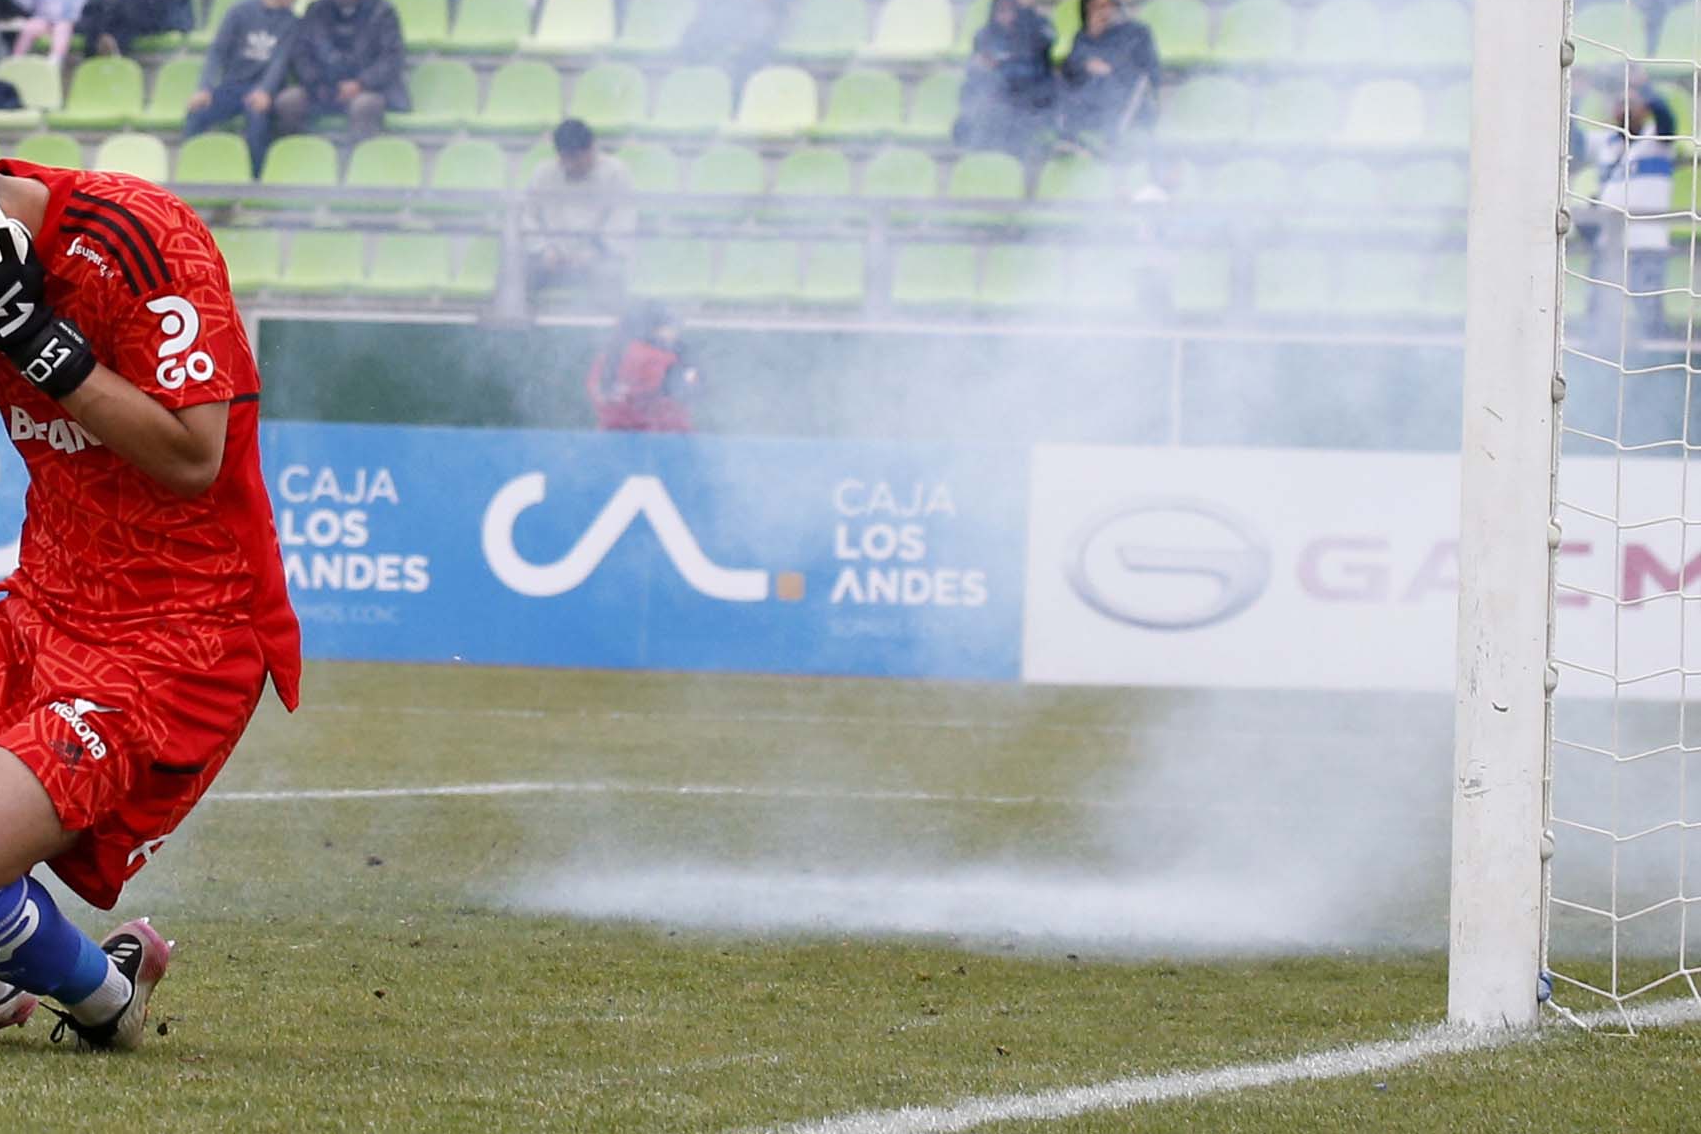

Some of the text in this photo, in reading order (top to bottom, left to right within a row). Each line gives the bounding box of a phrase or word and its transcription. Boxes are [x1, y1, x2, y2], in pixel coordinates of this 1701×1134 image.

[156, 351, 215, 390] GO
[278, 464, 400, 506] CAJA
[832, 479, 956, 517] CAJA
[281, 509, 369, 548] LOS
[835, 523, 927, 561] LOS
[285, 553, 430, 594] ANDES
[830, 568, 988, 607] ANDES
